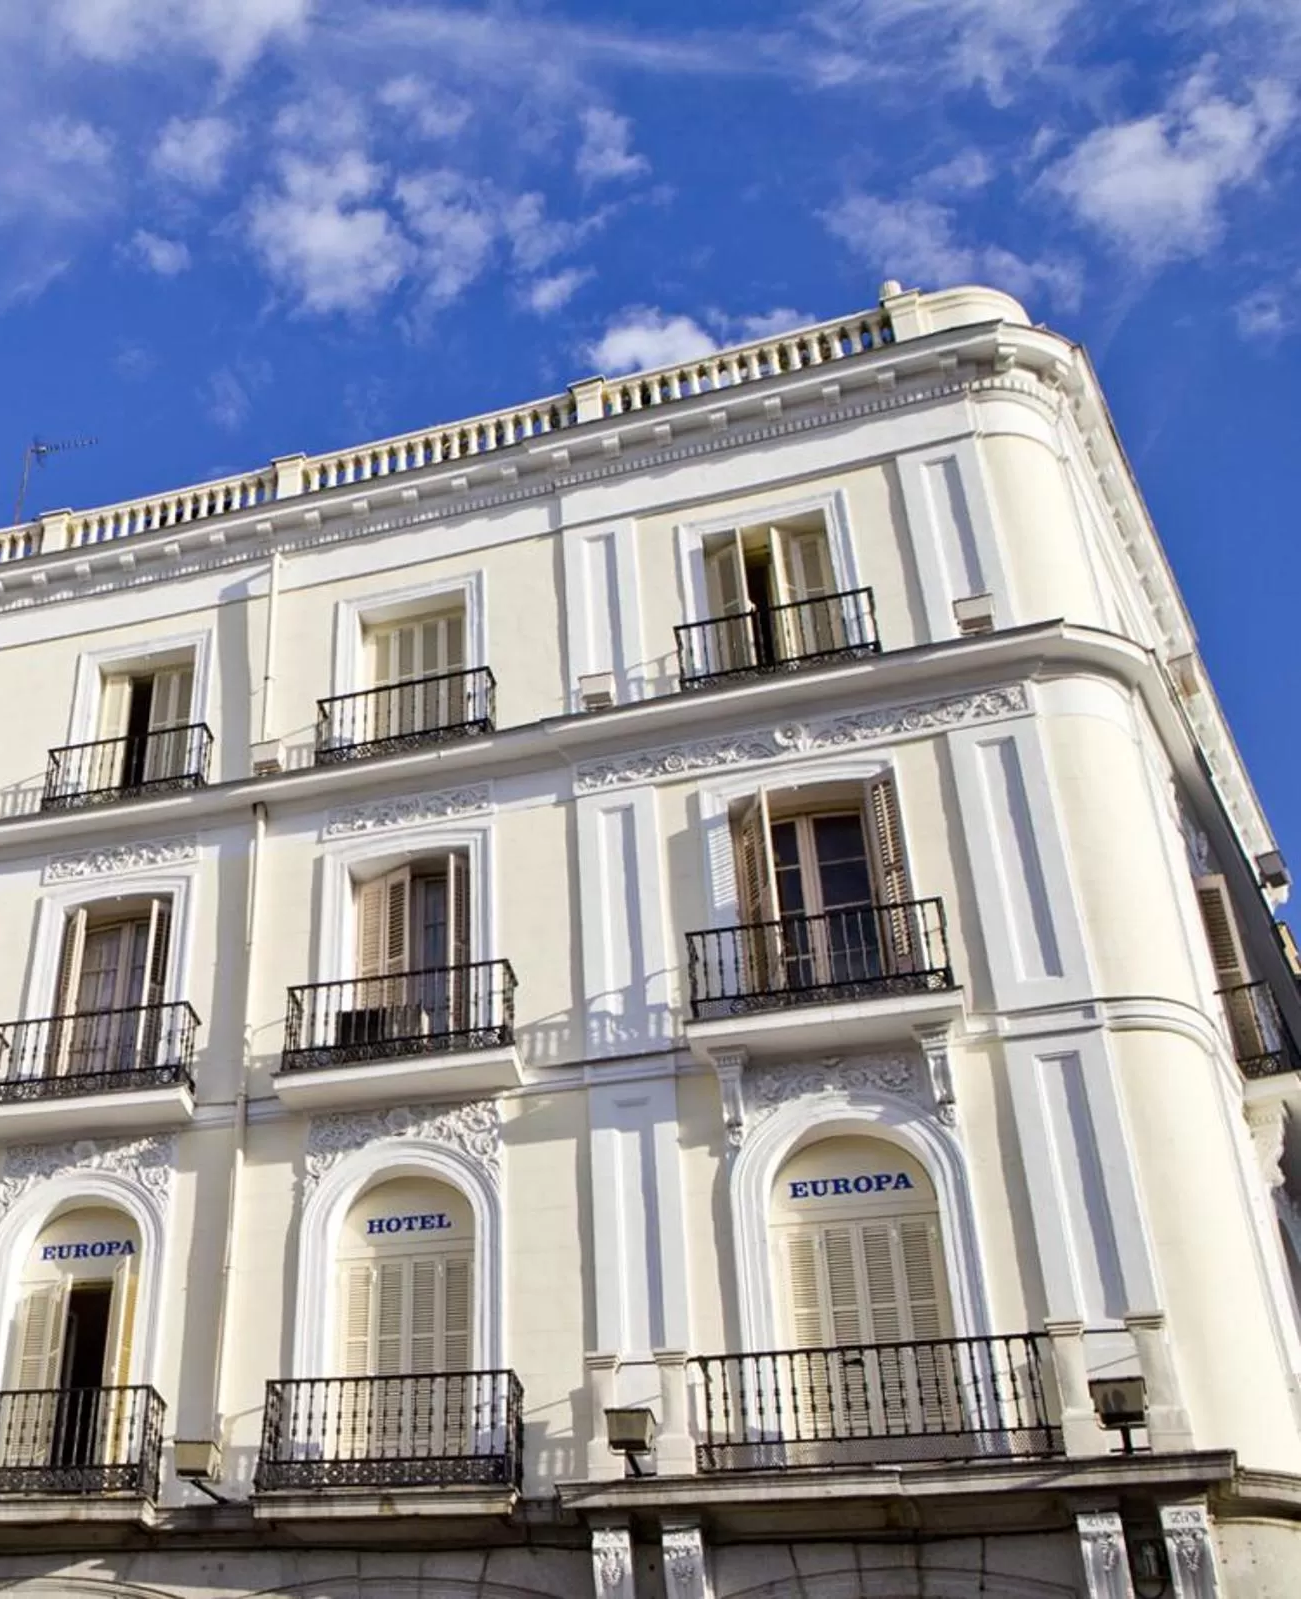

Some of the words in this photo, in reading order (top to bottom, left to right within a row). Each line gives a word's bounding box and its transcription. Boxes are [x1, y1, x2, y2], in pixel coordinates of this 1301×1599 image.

[789, 1173, 914, 1198] EUROPA
[367, 1213, 451, 1234] HOTEL
[42, 1240, 135, 1260] EUROPA
